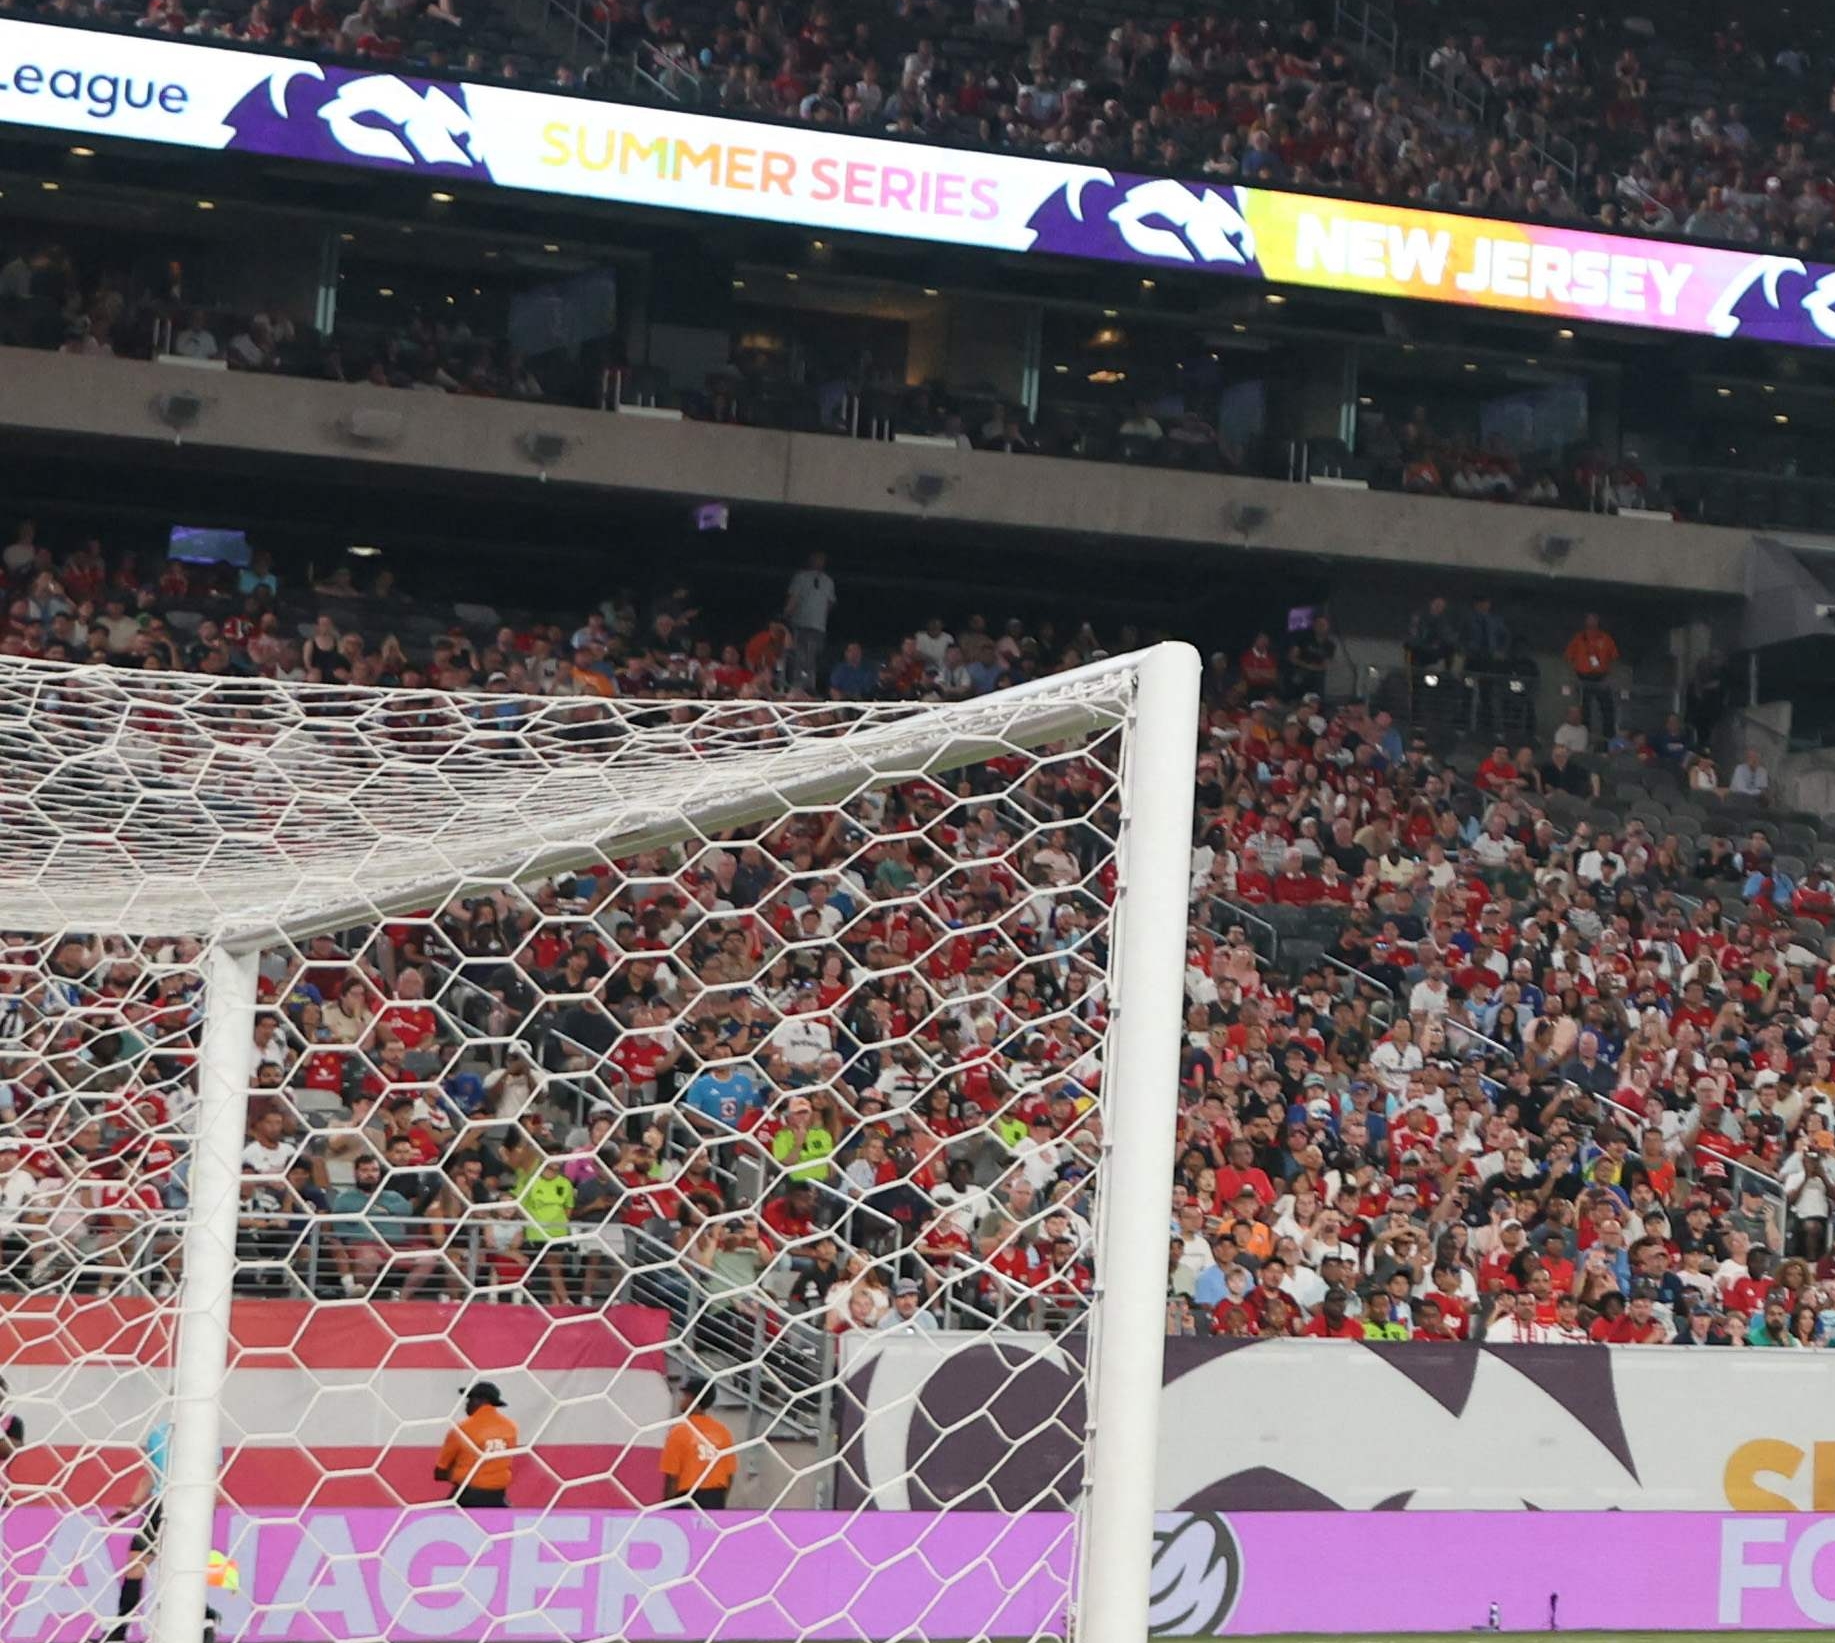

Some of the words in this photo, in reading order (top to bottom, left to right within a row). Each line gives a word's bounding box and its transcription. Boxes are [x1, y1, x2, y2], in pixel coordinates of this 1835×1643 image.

[0, 61, 189, 118] eague
[538, 120, 797, 197] SUMMER
[809, 158, 1000, 221] SERIES
[1296, 213, 1451, 286] NEW
[1456, 235, 1694, 316] JERSEY
